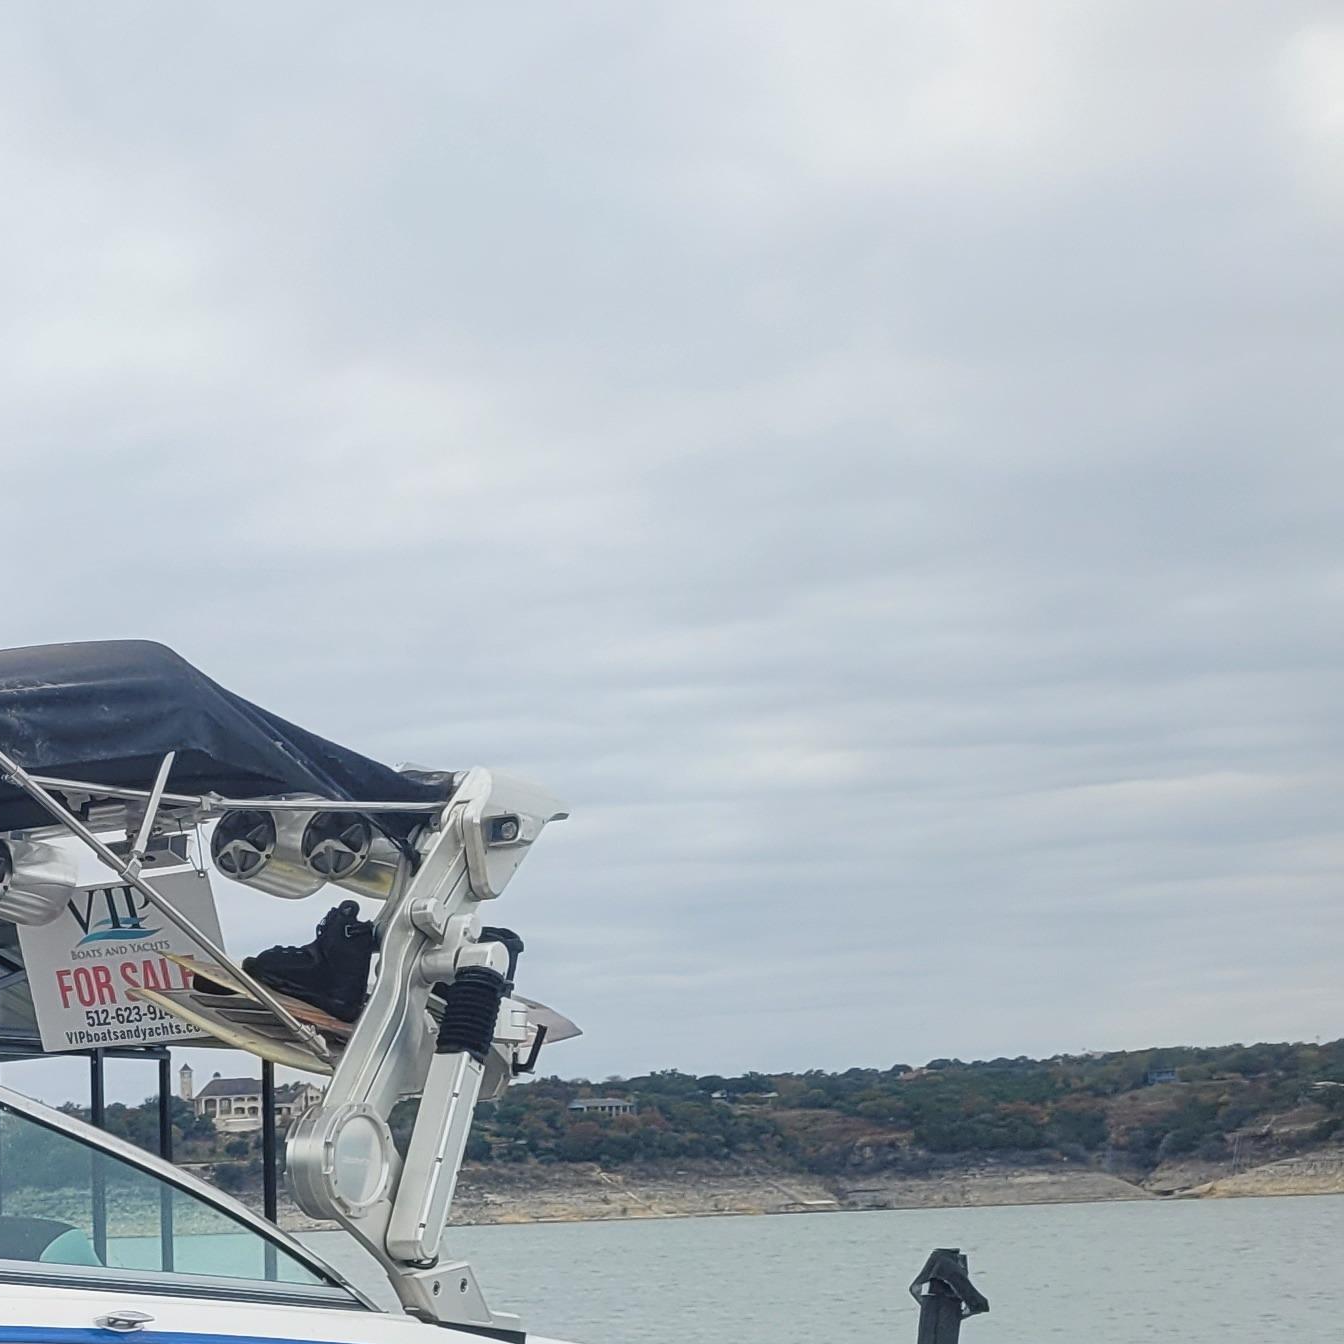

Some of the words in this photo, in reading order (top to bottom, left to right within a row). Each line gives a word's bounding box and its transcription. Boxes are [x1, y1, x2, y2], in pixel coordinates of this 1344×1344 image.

[70, 949, 102, 960] BOATS
[105, 945, 127, 957] AND
[56, 965, 117, 1009] FOR
